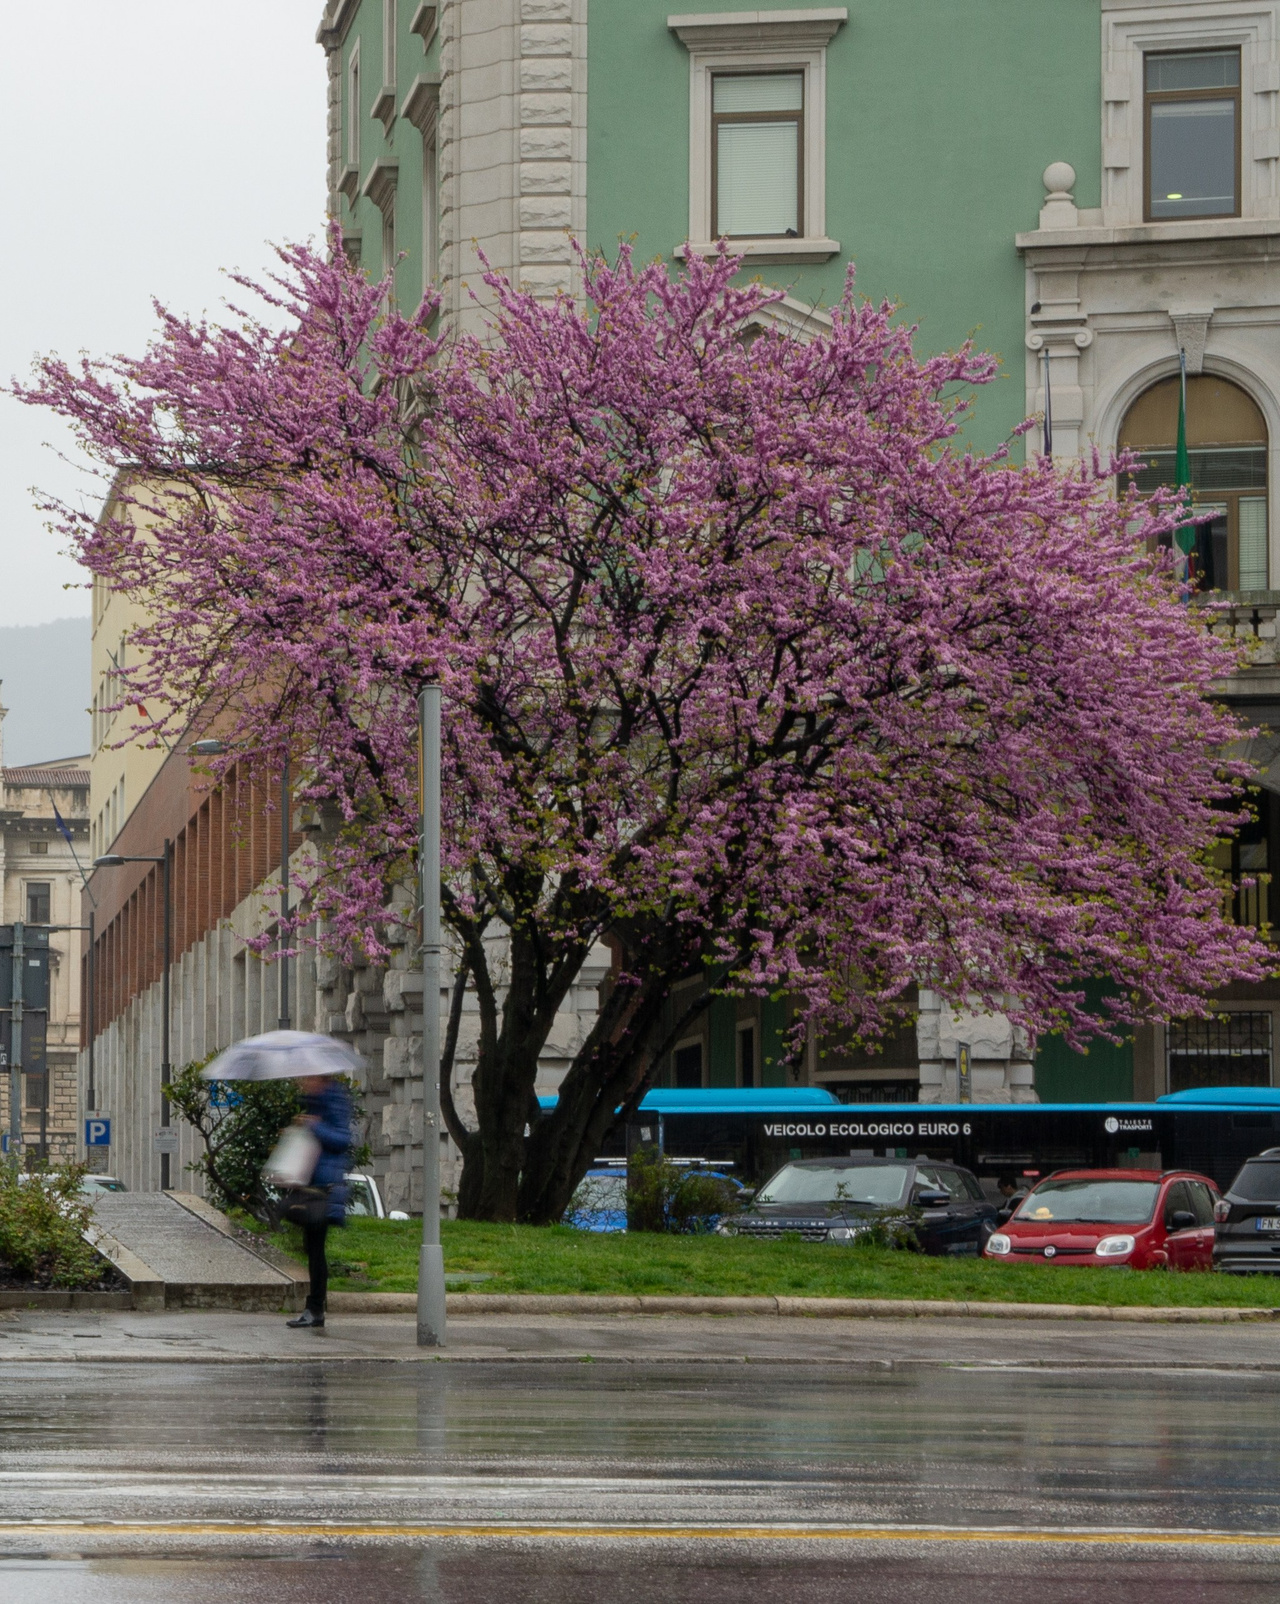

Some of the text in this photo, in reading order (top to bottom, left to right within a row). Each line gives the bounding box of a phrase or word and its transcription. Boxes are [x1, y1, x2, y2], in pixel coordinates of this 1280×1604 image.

[90, 1122, 106, 1143] P
[764, 1123, 971, 1136] VEICOLO ECOLOGICO EURO 6
